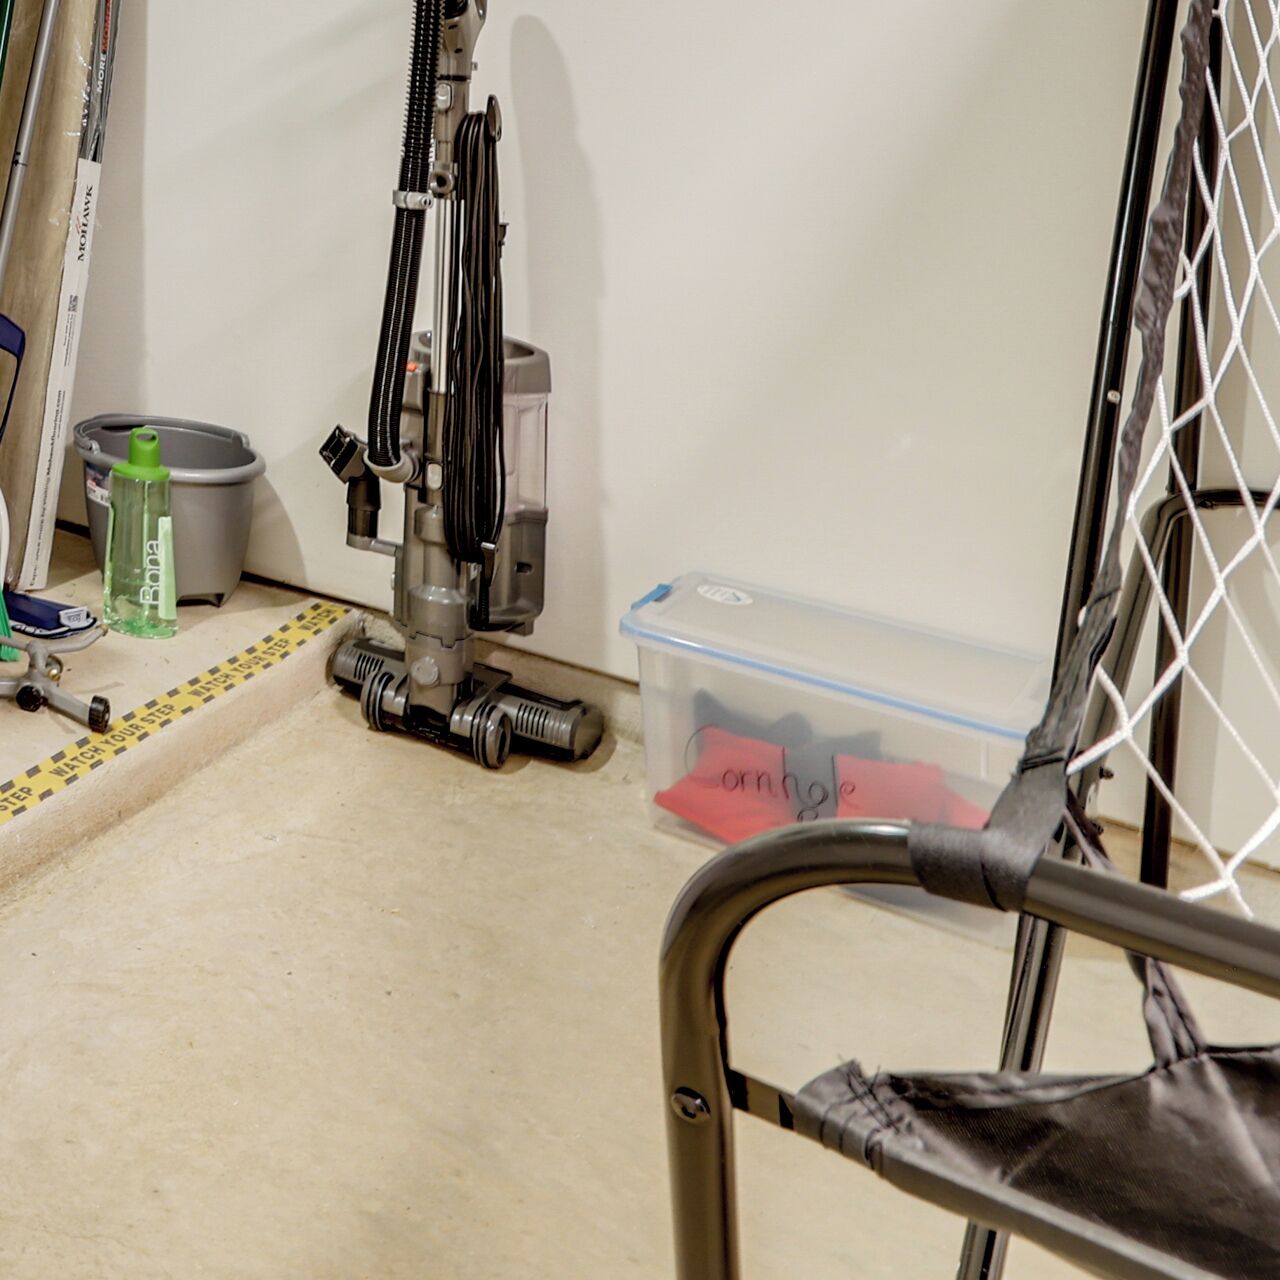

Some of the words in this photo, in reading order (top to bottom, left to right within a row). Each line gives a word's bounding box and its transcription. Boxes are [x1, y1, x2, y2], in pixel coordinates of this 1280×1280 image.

[96, 54, 107, 93] MORE
[77, 185, 93, 262] MOHAWK
[140, 539, 161, 605] Bona
[297, 608, 337, 632] WATCH
[188, 672, 235, 699] WATCH
[231, 655, 265, 676] YOUR
[263, 637, 291, 658] STEP
[48, 745, 105, 779] WATCH
[101, 721, 144, 747] YOUR
[143, 703, 176, 725] STEP
